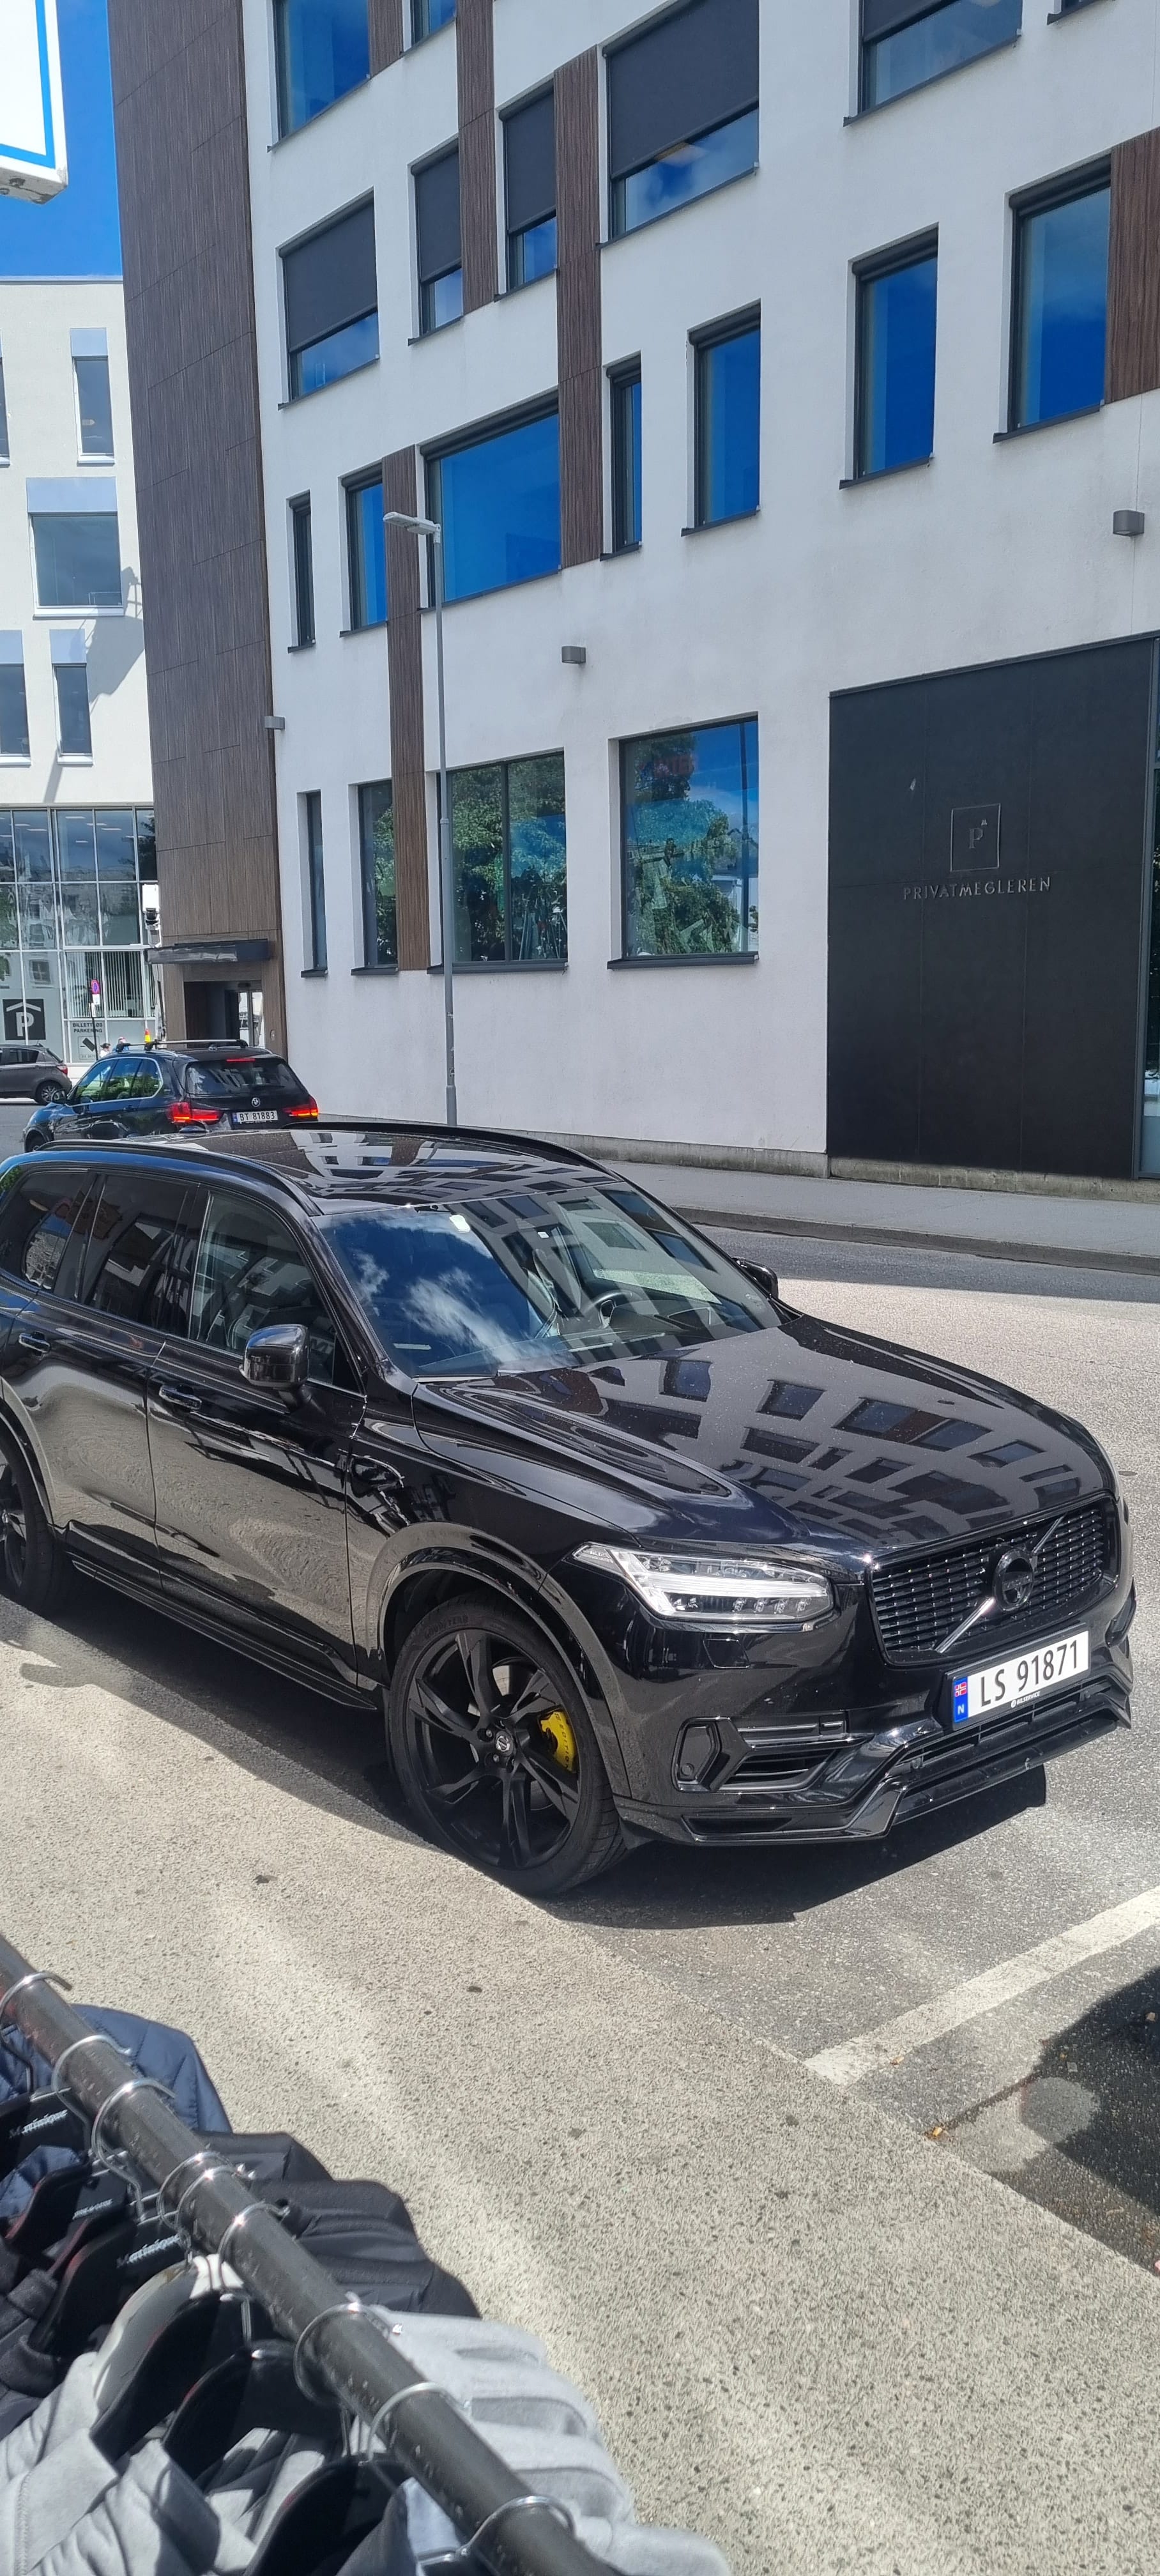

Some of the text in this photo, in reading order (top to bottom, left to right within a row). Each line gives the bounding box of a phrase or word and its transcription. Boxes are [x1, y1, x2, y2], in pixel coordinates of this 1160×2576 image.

[968, 827, 984, 849] P
[903, 877, 1051, 900] PRIVATMEGLEREN
[16, 1011, 34, 1037] P
[240, 1112, 275, 1121] BT 81883
[981, 1639, 1078, 1708] LS 91871
[958, 1705, 965, 1715] N
